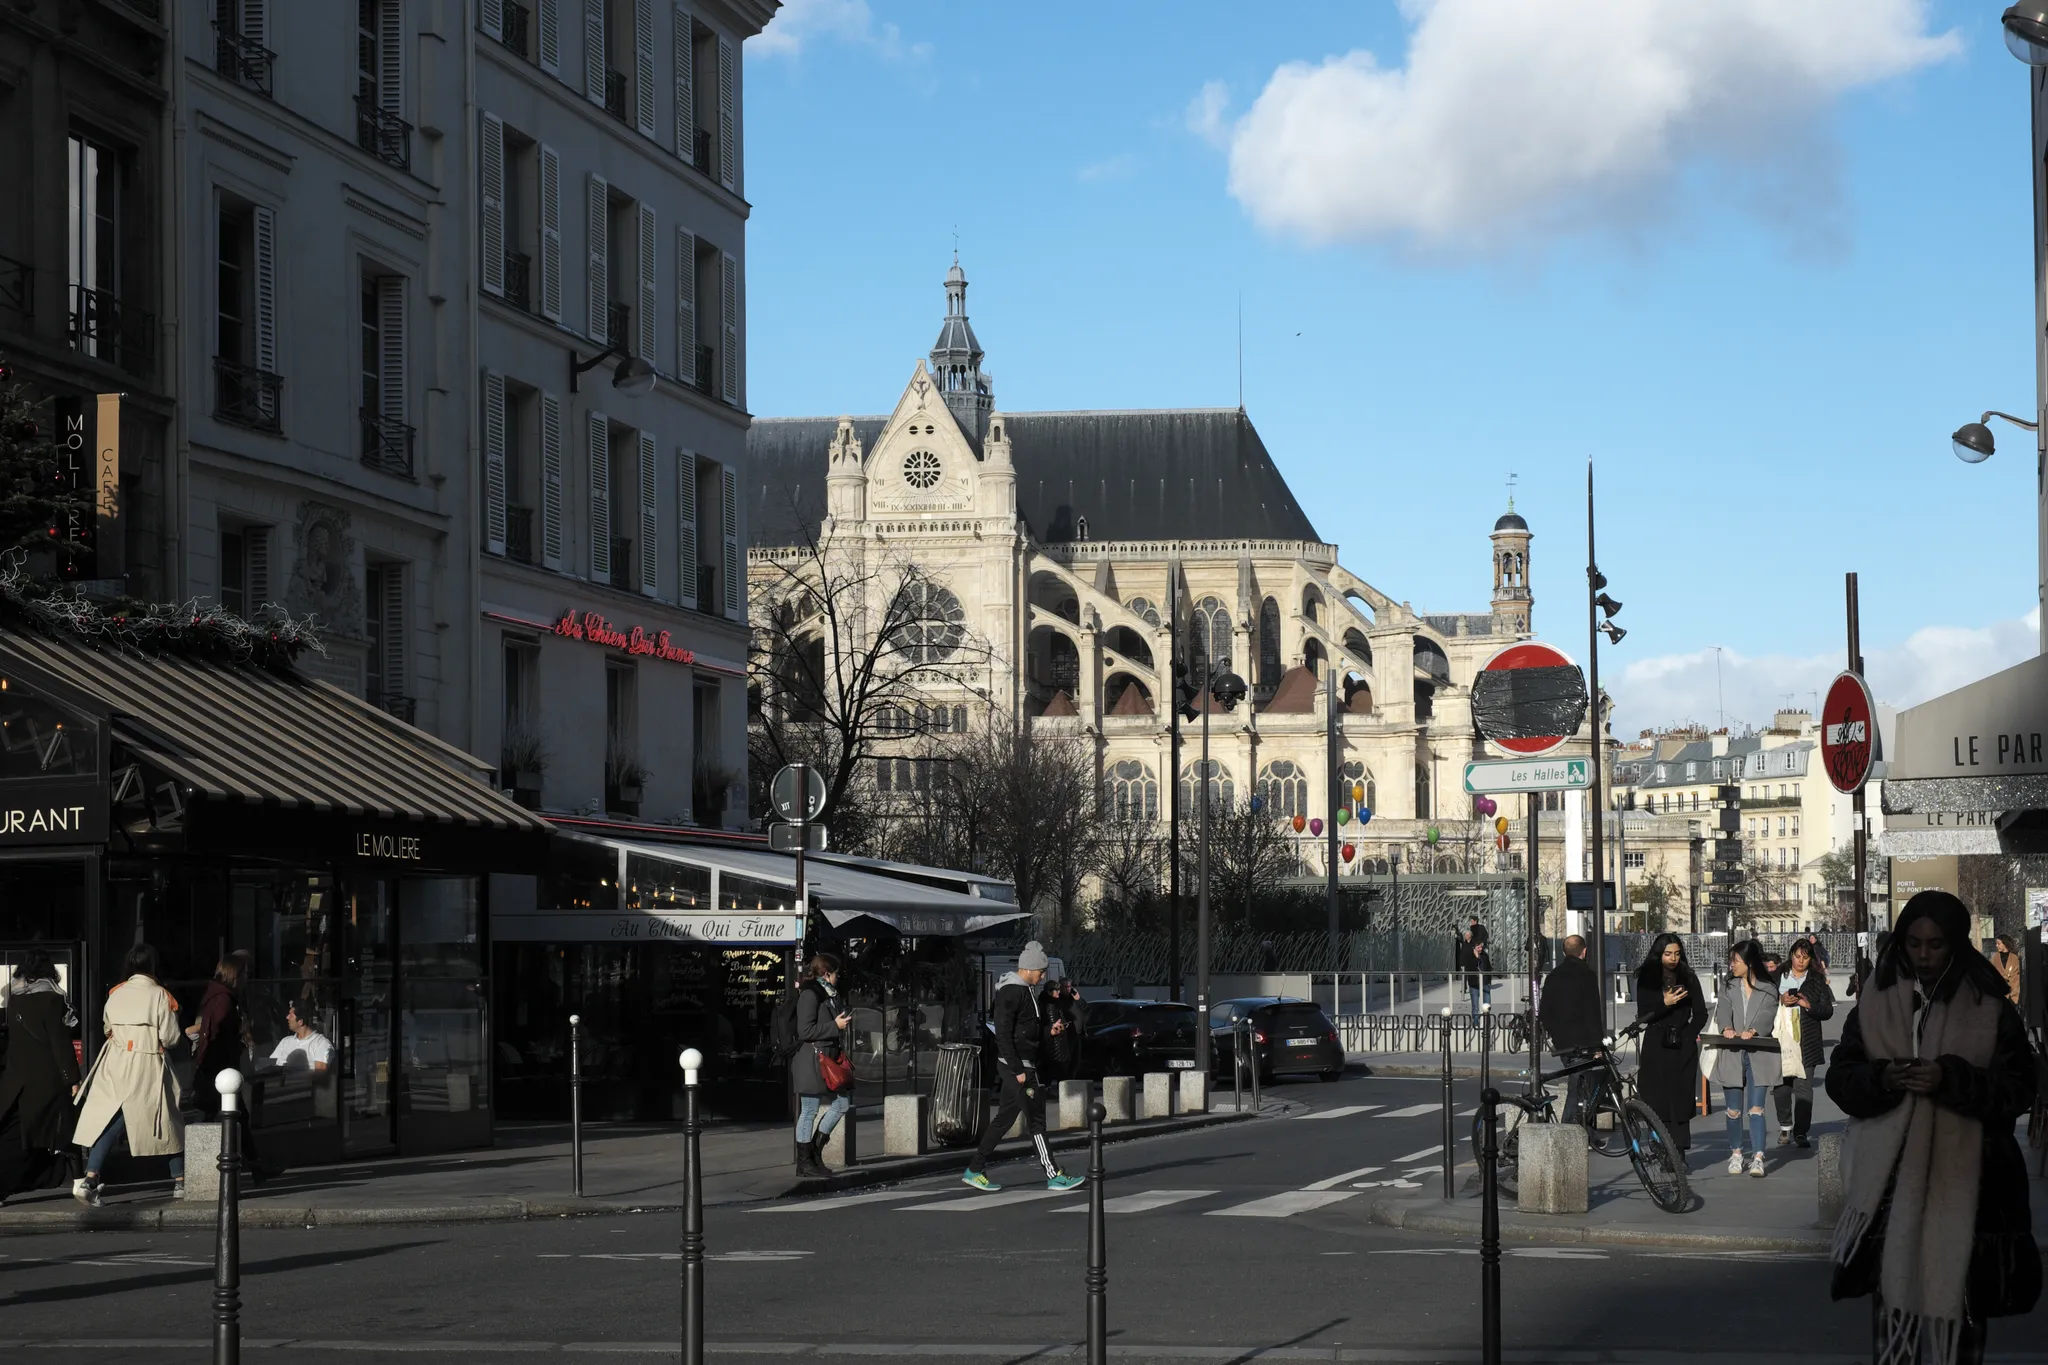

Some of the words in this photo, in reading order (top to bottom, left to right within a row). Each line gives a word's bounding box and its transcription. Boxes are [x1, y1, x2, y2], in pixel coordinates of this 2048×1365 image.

[67, 414, 83, 545] MOLIRE
[555, 609, 584, 639] Au
[585, 611, 628, 649] Chien
[629, 626, 656, 655] Qui
[657, 630, 695, 664] Fume
[1954, 736, 1979, 766] LE
[1998, 733, 2042, 764] PAR
[1511, 769, 1528, 782] Les
[1533, 767, 1566, 781] Halles
[1927, 811, 1944, 826] LE
[356, 833, 371, 856] LE
[372, 835, 421, 860] MOLIERE
[611, 919, 639, 937] Au
[647, 917, 692, 937] Chien
[702, 919, 731, 940] Qui
[738, 917, 785, 937] Fume
